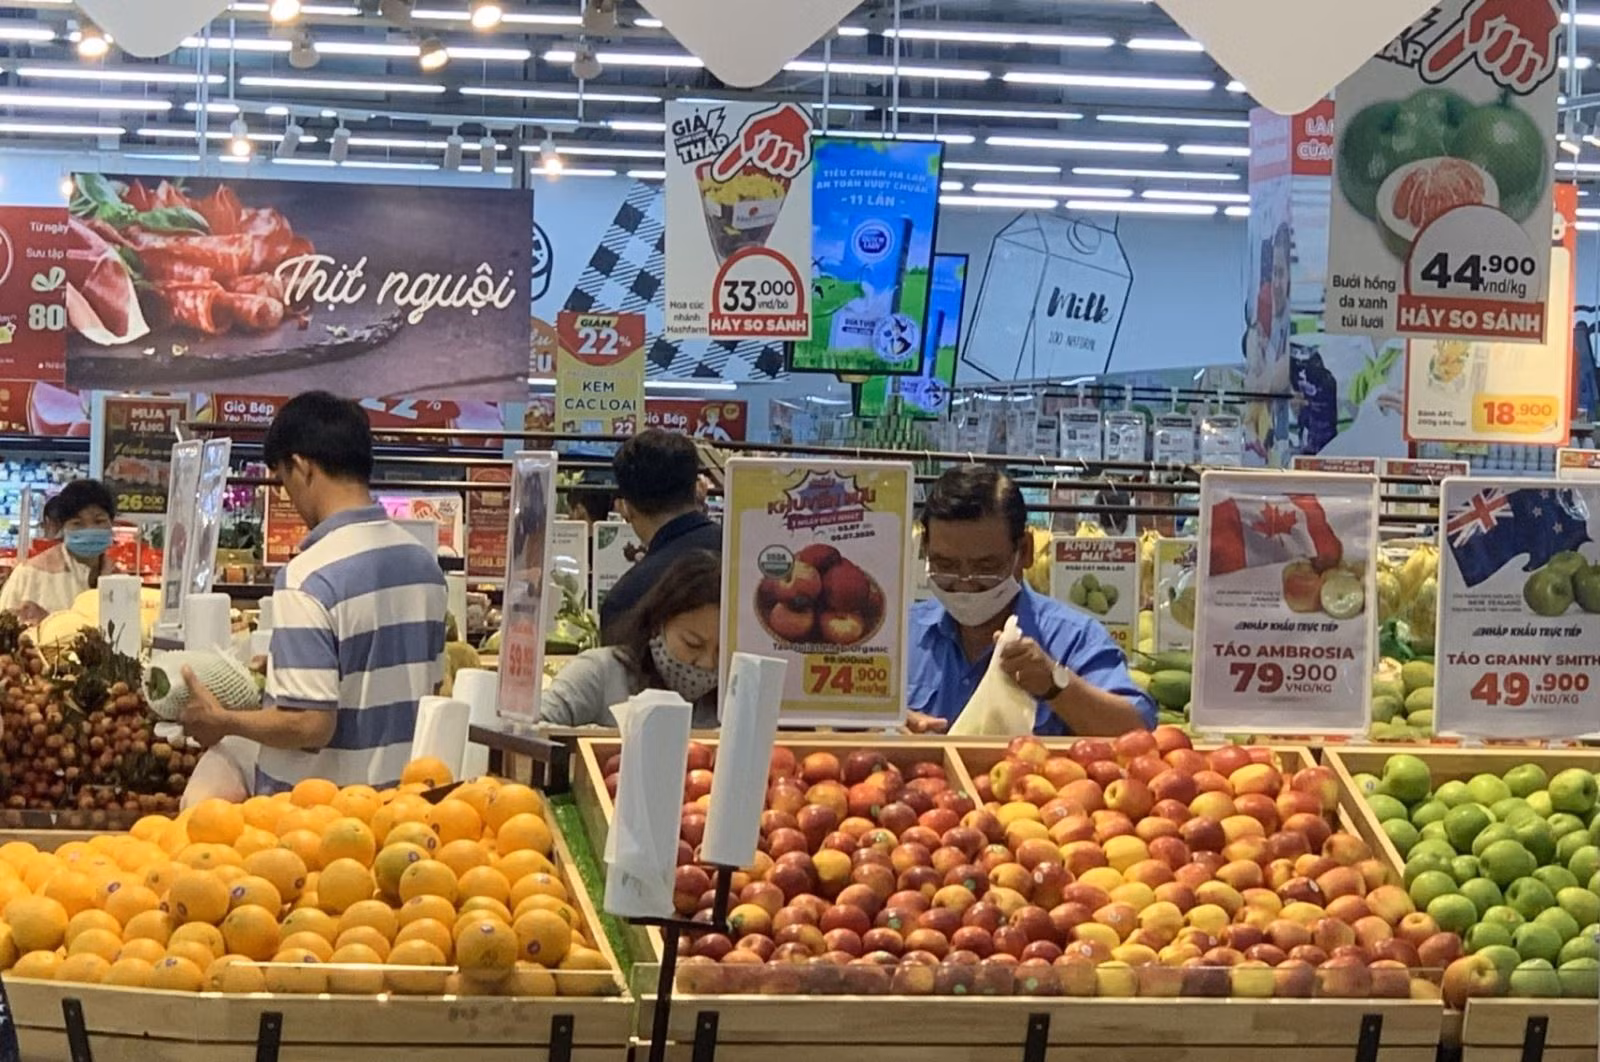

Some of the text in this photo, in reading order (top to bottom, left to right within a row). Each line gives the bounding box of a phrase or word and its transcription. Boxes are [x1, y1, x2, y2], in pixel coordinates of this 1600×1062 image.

[672, 107, 707, 136] GIÁ
[1421, 252, 1536, 292] 44.900
[275, 254, 516, 325] Thịt nguội
[723, 280, 796, 312] 33.000
[1481, 279, 1527, 298] vnd/kg
[1047, 286, 1113, 325] Milk
[1339, 294, 1388, 310] da xanh
[28, 304, 67, 330] 80
[744, 319, 764, 332] SO
[767, 317, 807, 332] SÁNH
[1449, 311, 1478, 329] SO
[1482, 308, 1541, 332] SÁNH
[583, 381, 615, 392] KEM
[131, 407, 165, 419] MUA
[1213, 640, 1354, 659] TÁO AMBROSIA
[1447, 651, 1600, 666] TÁO GRANNY SMITH
[1230, 662, 1337, 693] 79.900
[1285, 683, 1332, 693] VND/KG
[1470, 672, 1590, 706] 49.900
[1531, 694, 1579, 704] VND/KG
